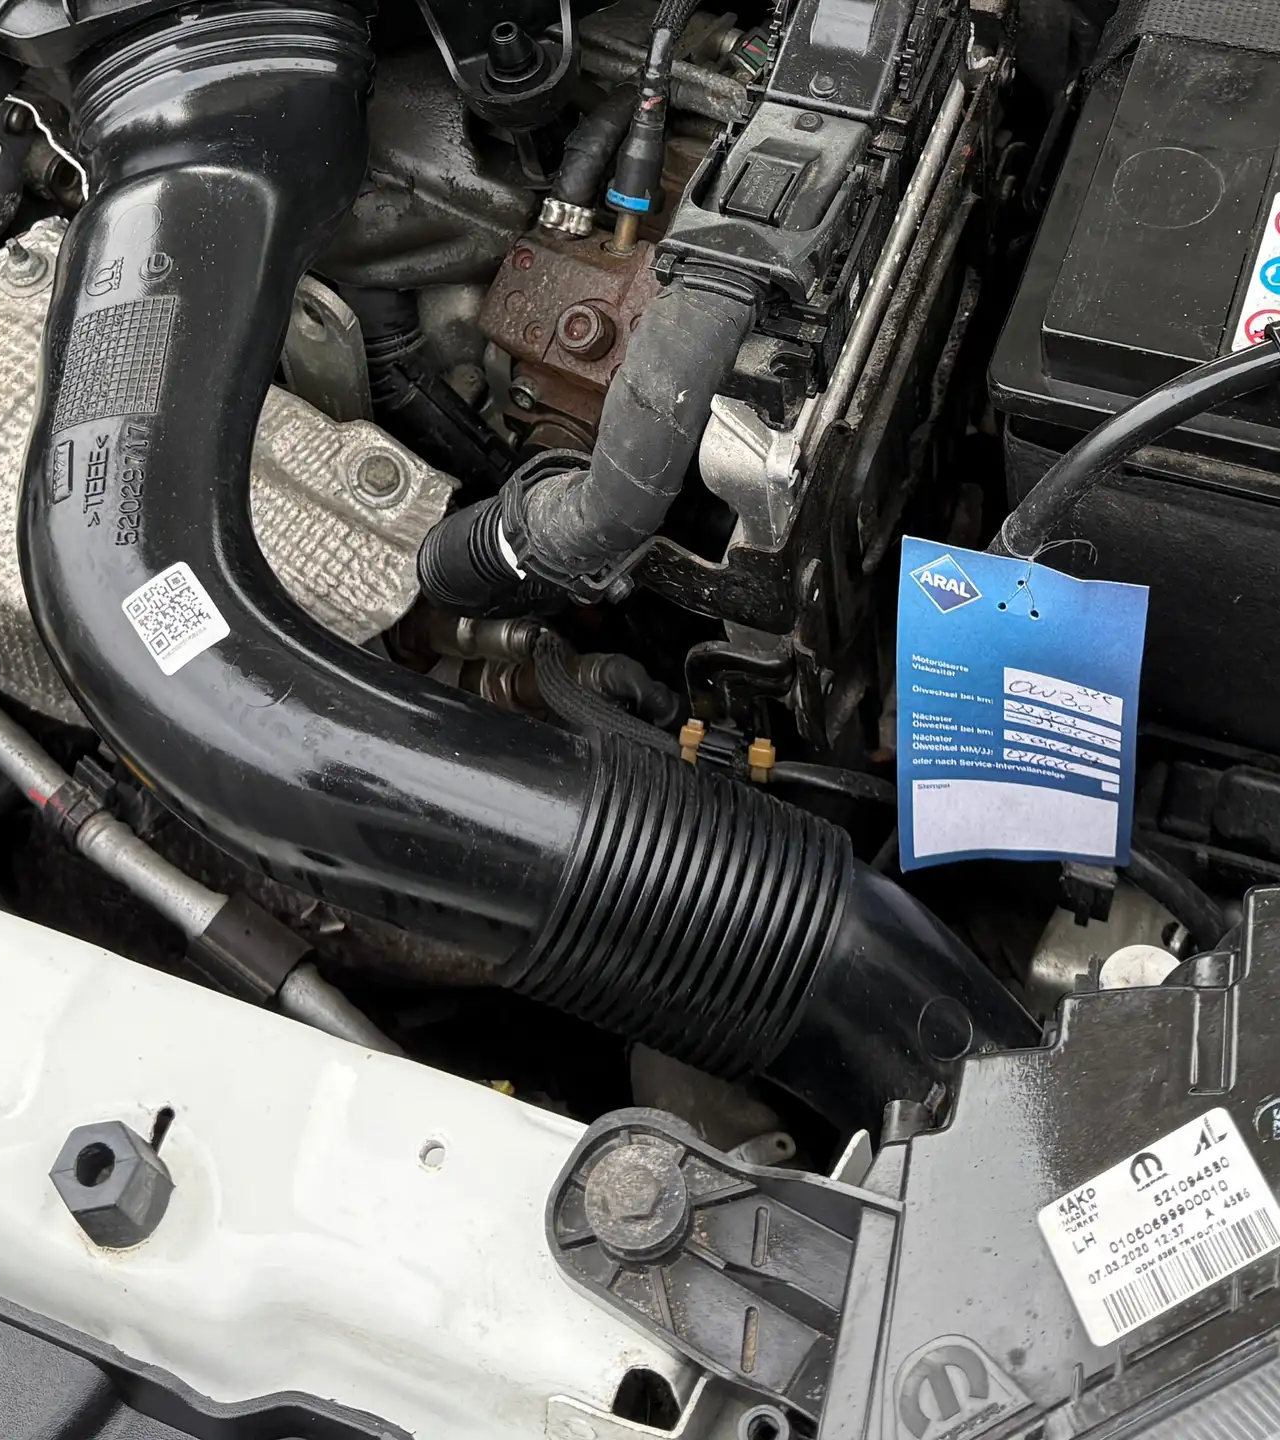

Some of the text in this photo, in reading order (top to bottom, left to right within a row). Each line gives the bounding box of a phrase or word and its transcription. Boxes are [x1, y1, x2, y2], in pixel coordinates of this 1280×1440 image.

[115, 420, 154, 548] 52029717
[919, 570, 971, 598] ARAL
[912, 758, 932, 766] oder
[935, 758, 957, 766] nach
[1059, 1201, 1098, 1227] MADE IN
[1063, 1211, 1101, 1236] TURKEY
[1072, 1233, 1097, 1255] LH
